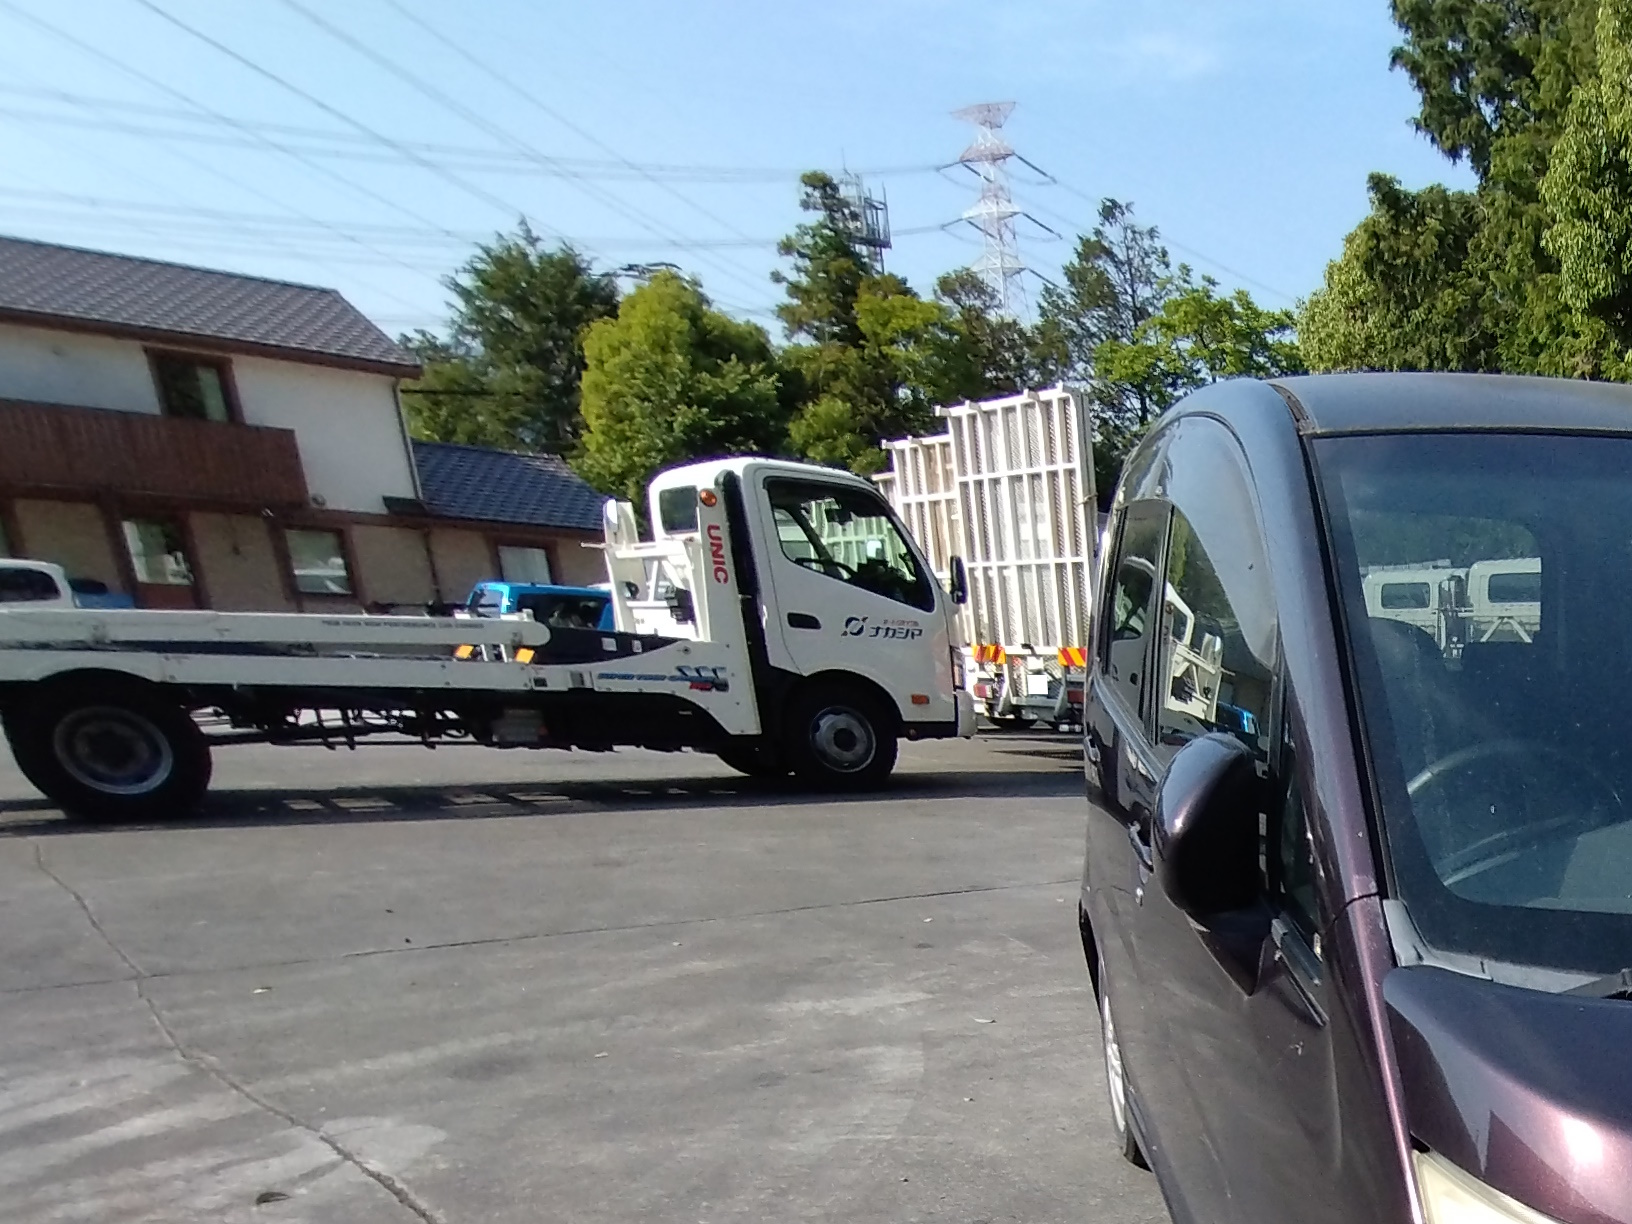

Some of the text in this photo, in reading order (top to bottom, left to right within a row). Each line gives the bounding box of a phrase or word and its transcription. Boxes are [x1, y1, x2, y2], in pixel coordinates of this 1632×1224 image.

[707, 524, 729, 584] UNIC
[868, 625, 923, 640] ナカシマ
